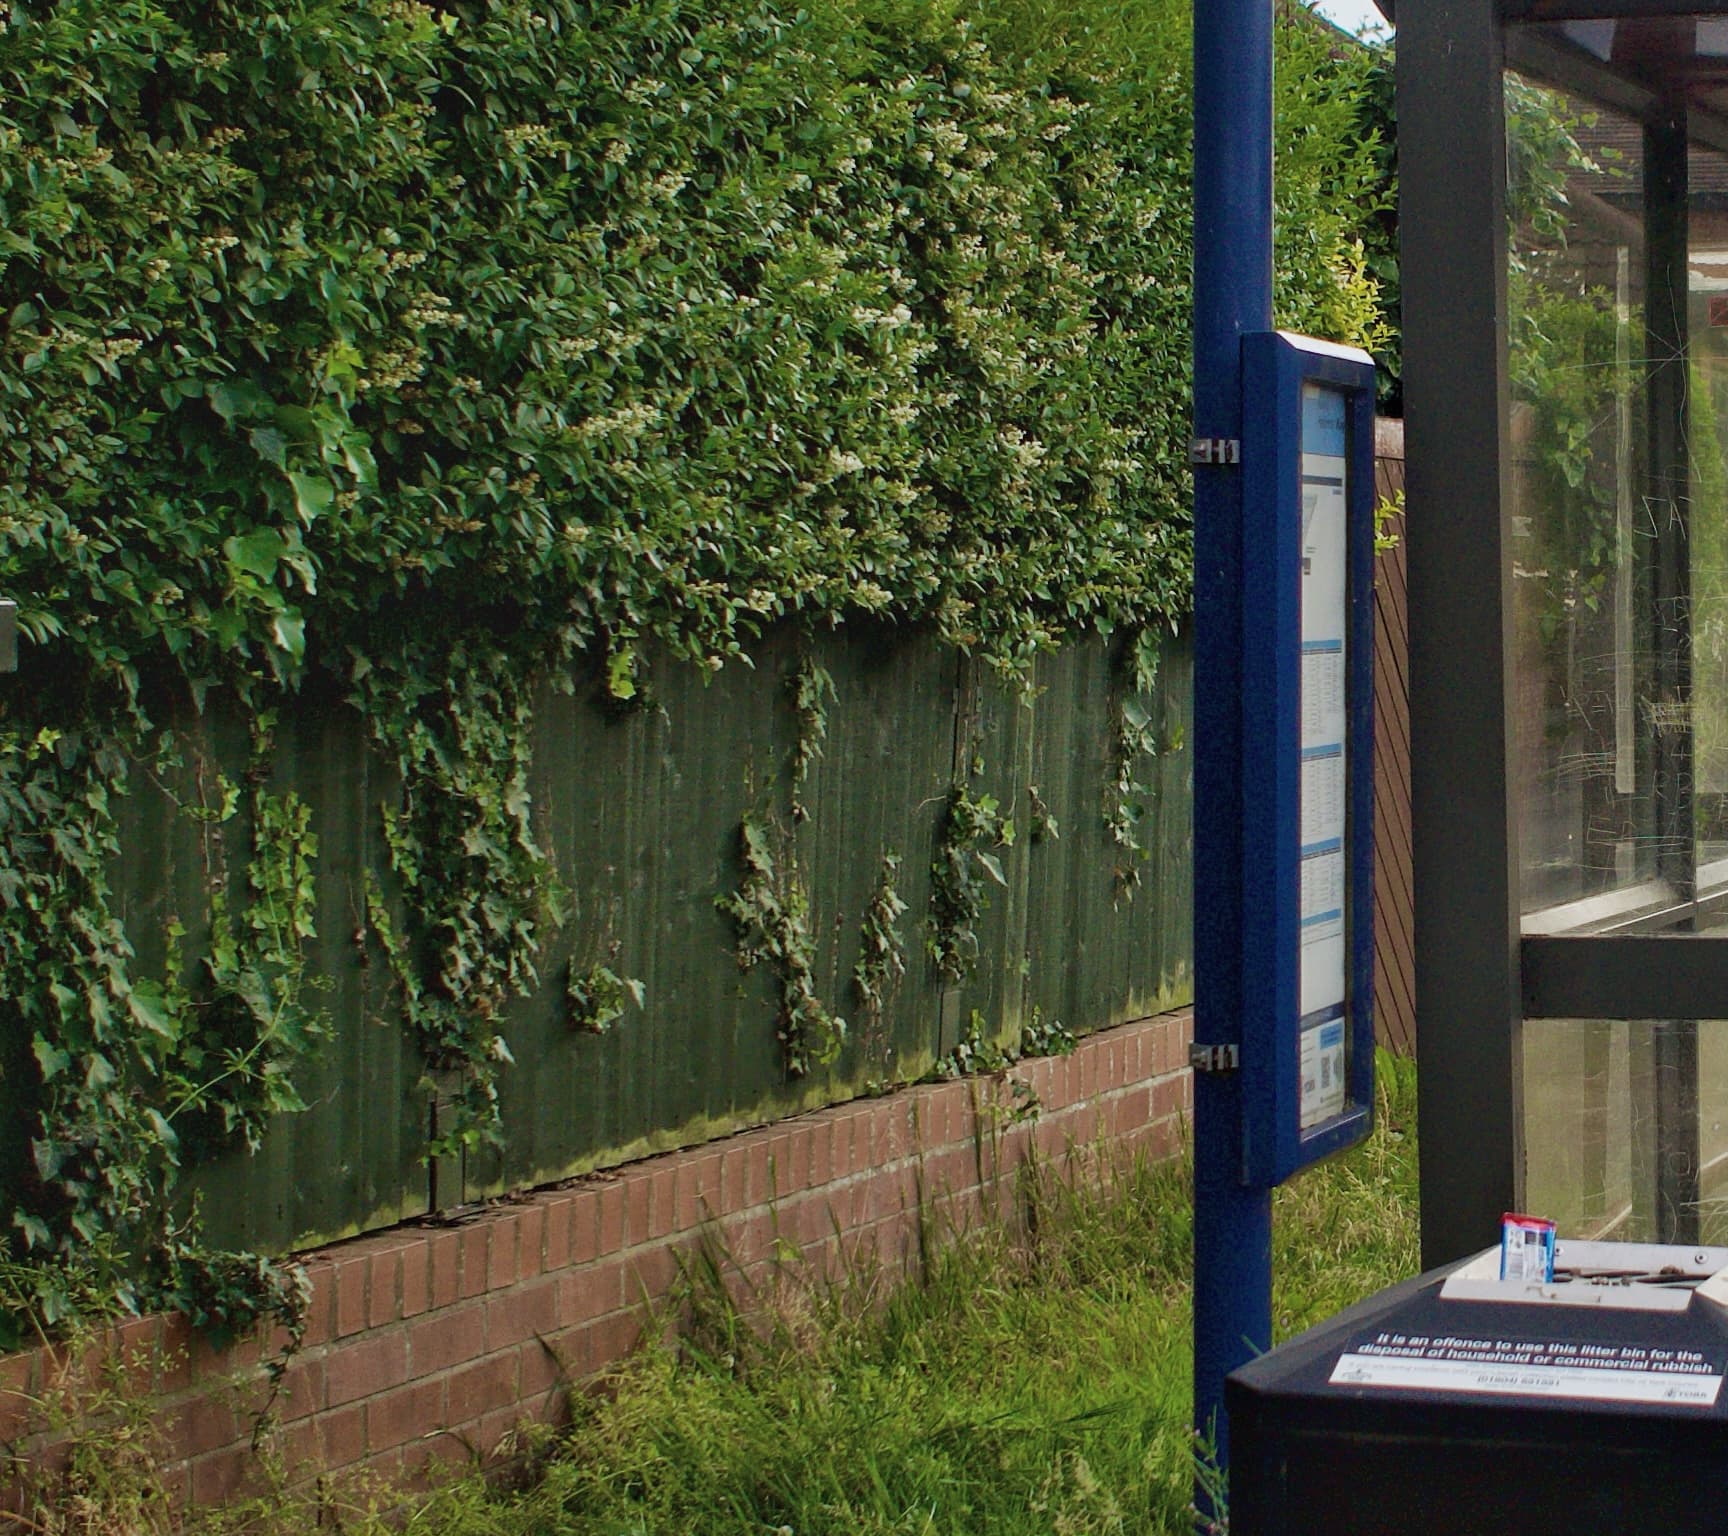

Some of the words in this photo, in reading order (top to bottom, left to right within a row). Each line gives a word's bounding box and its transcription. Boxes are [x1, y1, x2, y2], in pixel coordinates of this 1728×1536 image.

[1358, 1344, 1425, 1357] disposal
[1427, 1347, 1446, 1358] of
[1447, 1348, 1531, 1363] household
[1533, 1355, 1553, 1364] or
[1555, 1355, 1648, 1370] commercial
[1652, 1360, 1713, 1374] rubbish
[1376, 1333, 1390, 1344] It
[1391, 1334, 1402, 1344] is
[1408, 1337, 1429, 1346] an
[1433, 1337, 1492, 1349] offence
[1495, 1341, 1512, 1351] to
[1515, 1343, 1544, 1353] use
[1549, 1343, 1577, 1354] this
[1581, 1344, 1617, 1357] litter
[1621, 1347, 1646, 1359] bin
[1650, 1348, 1674, 1361] for
[1677, 1350, 1703, 1362] the
